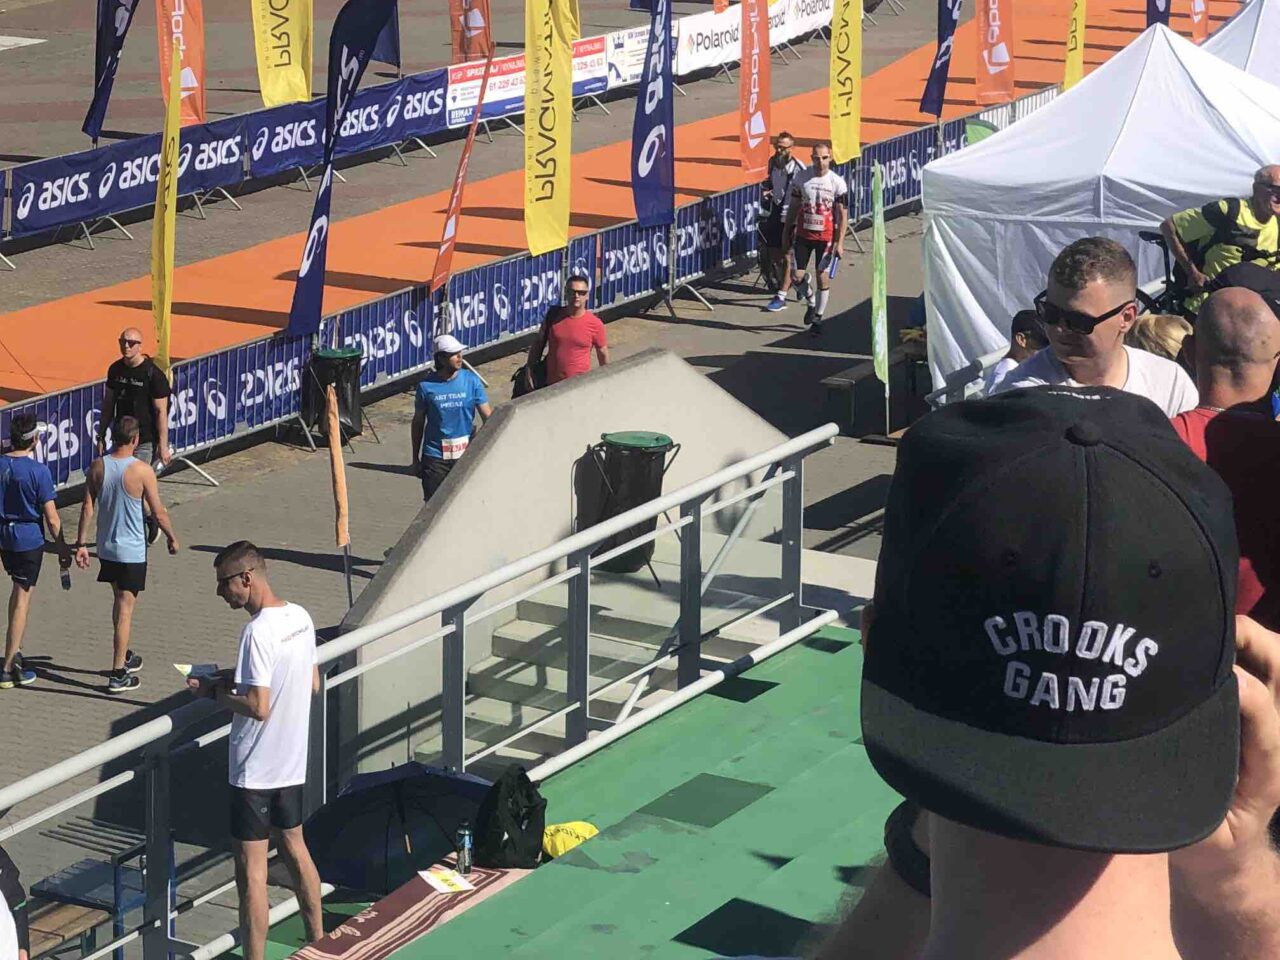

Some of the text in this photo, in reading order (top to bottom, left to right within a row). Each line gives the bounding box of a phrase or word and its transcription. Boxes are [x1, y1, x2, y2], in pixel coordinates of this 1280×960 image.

[767, 10, 786, 30] aroid
[695, 24, 739, 53] Polaroid
[404, 88, 443, 119] asics
[272, 119, 316, 152] asics
[196, 135, 241, 170] asics
[39, 174, 89, 210] asics
[448, 391, 467, 401] TEAM
[984, 610, 1158, 677] CROOKS
[1003, 660, 1127, 711] GANG
